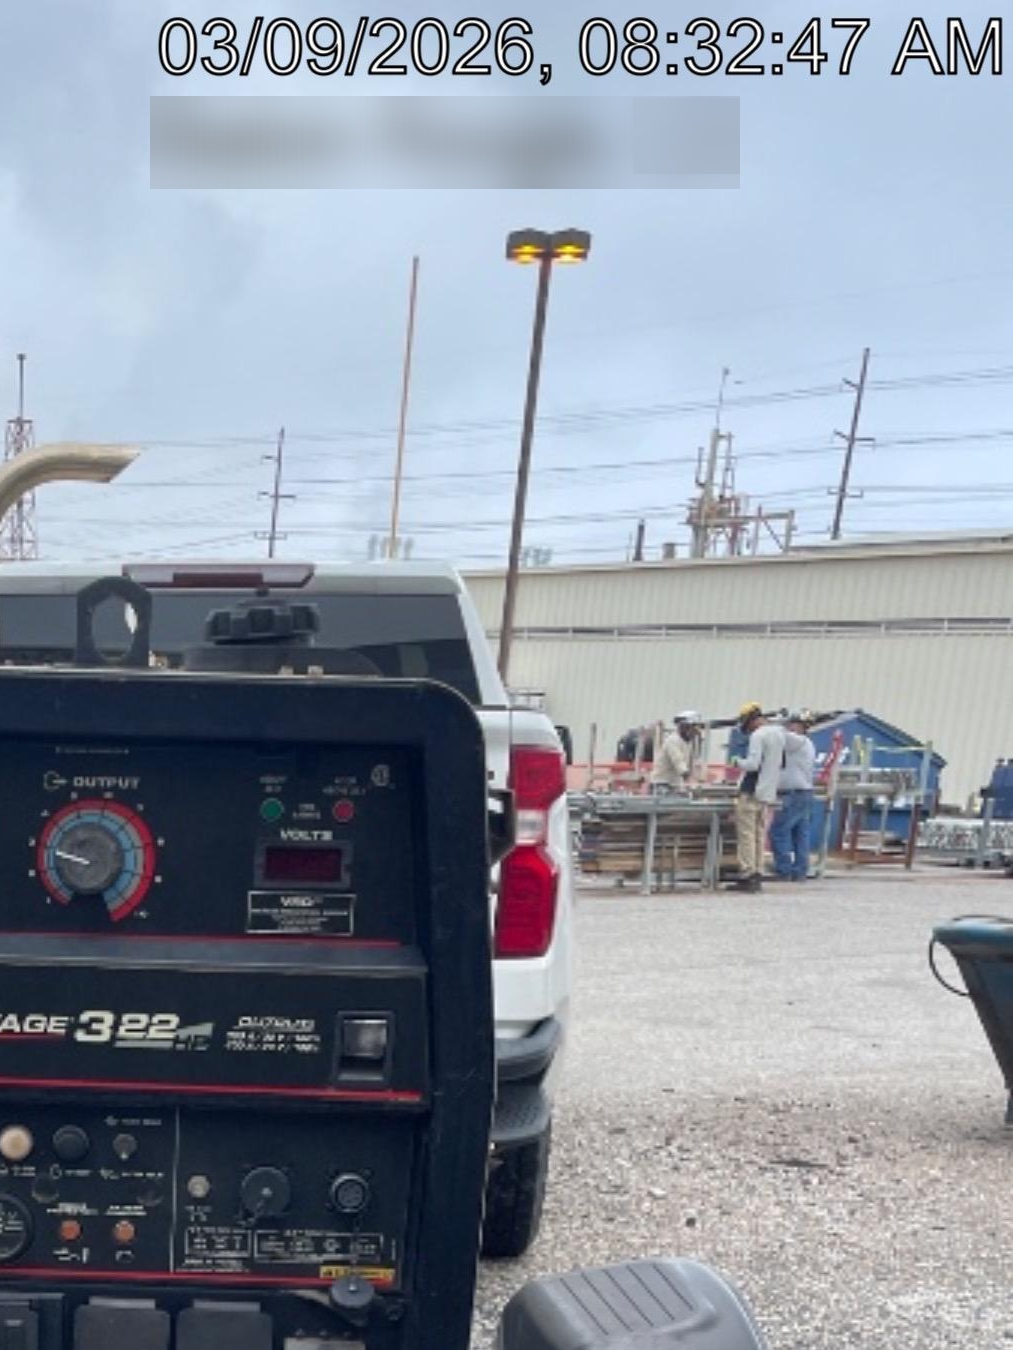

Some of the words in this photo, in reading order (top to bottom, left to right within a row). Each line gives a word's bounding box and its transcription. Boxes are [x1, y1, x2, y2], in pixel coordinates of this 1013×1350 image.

[73, 775, 141, 790] OUTPUT
[279, 827, 334, 842] VOLTS
[73, 1009, 181, 1043] 322
